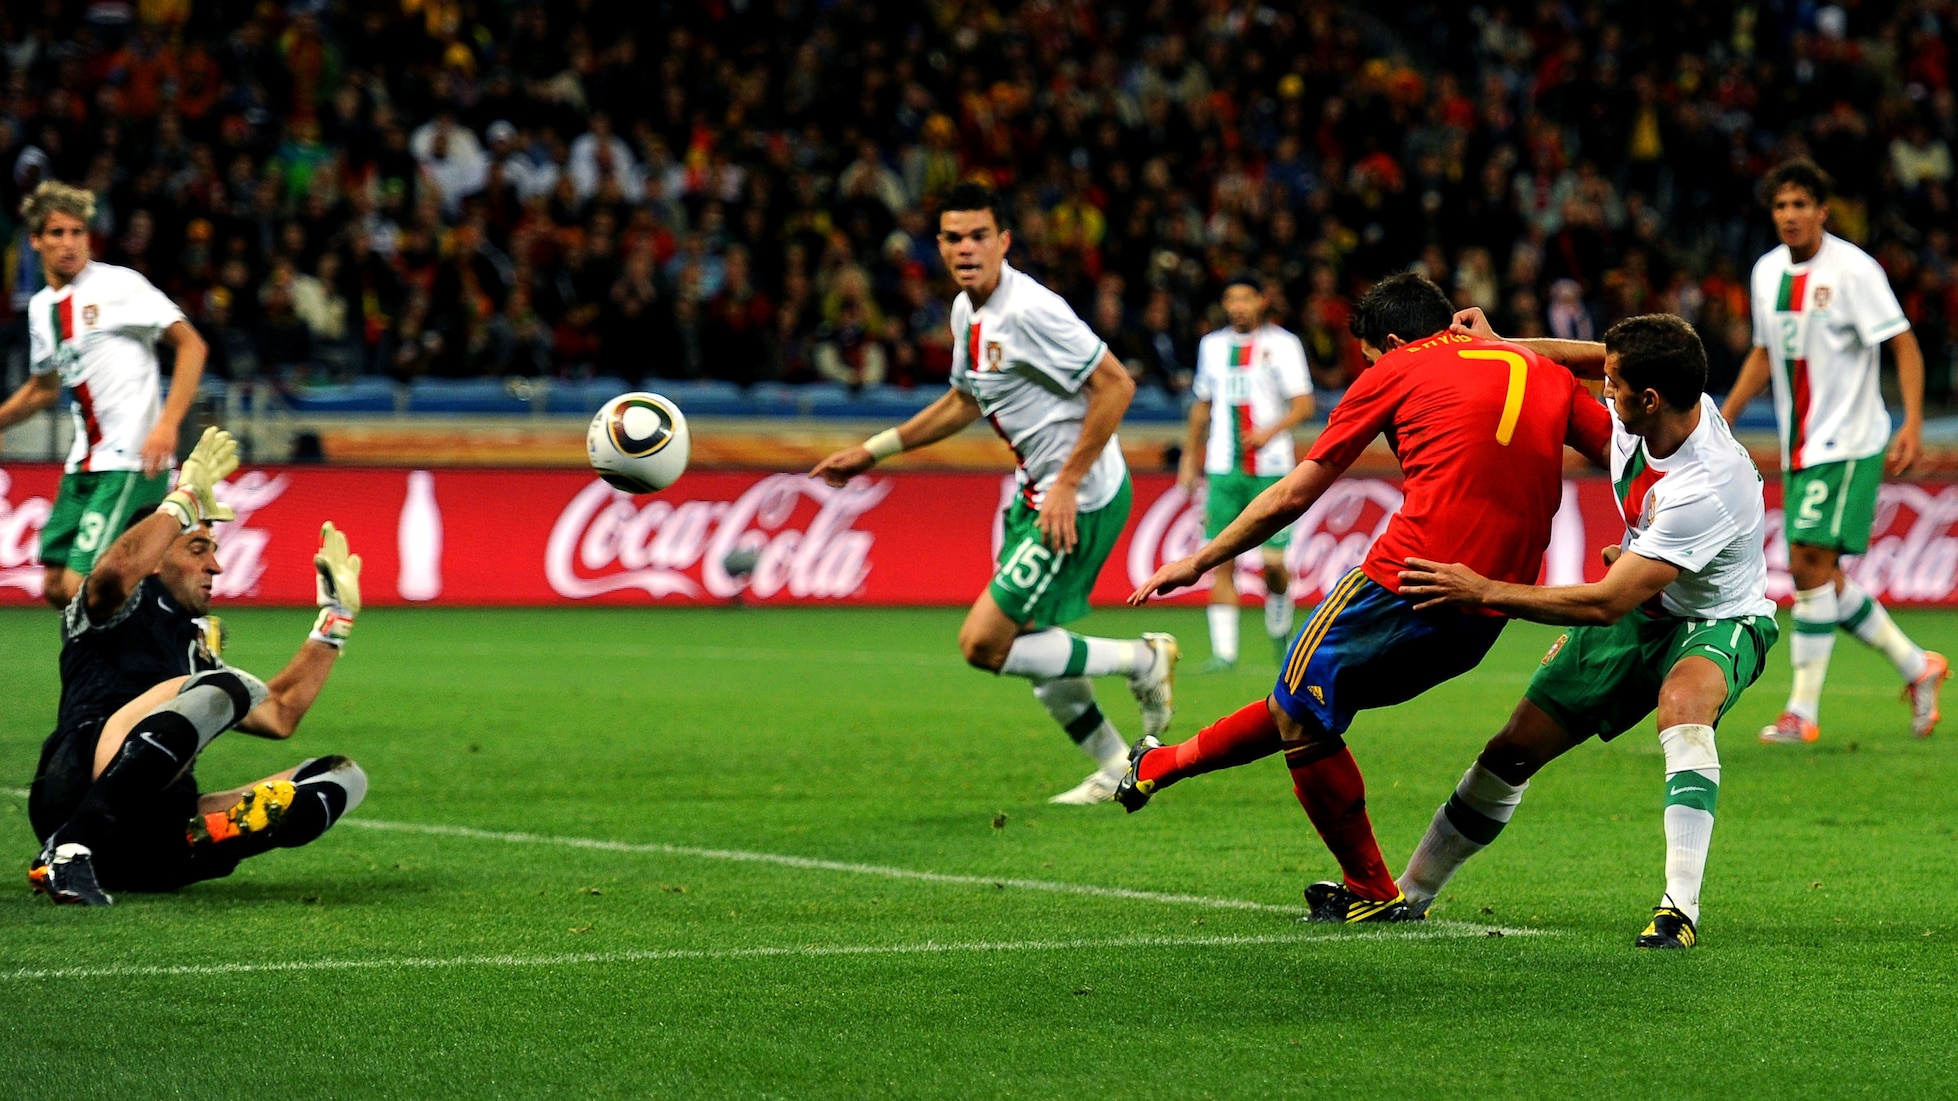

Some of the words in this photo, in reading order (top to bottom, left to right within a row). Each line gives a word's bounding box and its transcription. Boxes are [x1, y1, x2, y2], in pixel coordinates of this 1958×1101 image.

[1457, 349, 1528, 446] 7
[1800, 479, 1829, 520] 2
[1001, 536, 1050, 588] 15
